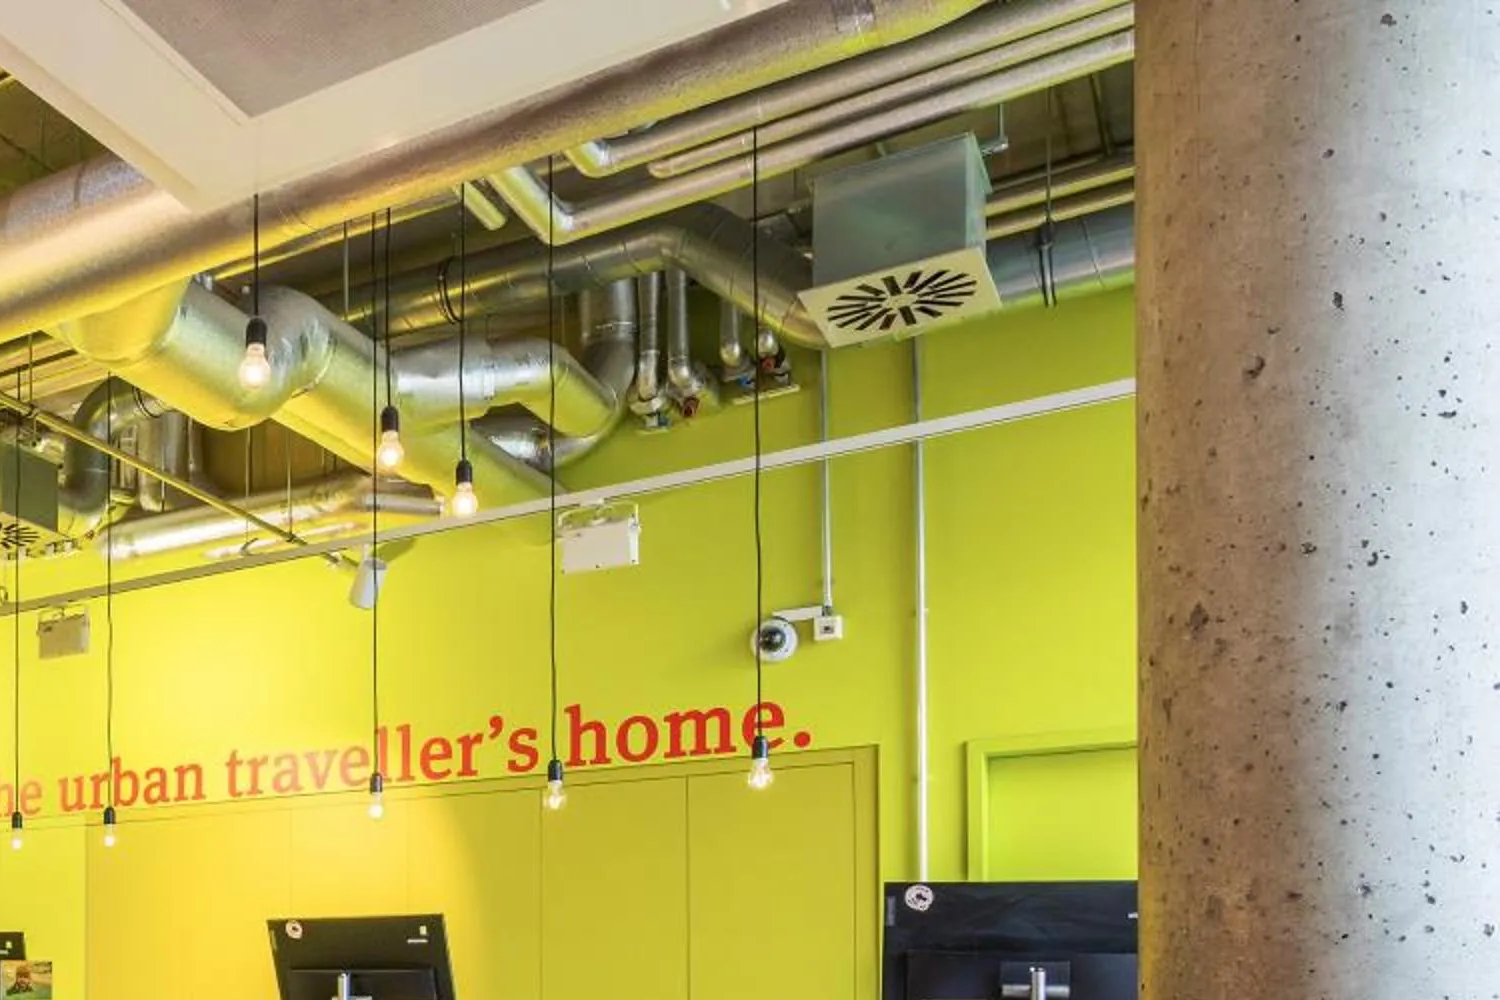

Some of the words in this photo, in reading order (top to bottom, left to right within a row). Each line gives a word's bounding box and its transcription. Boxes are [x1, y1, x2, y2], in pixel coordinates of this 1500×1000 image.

[58, 756, 206, 813] urban
[225, 715, 539, 798] traveller’s
[564, 701, 811, 766] home.
